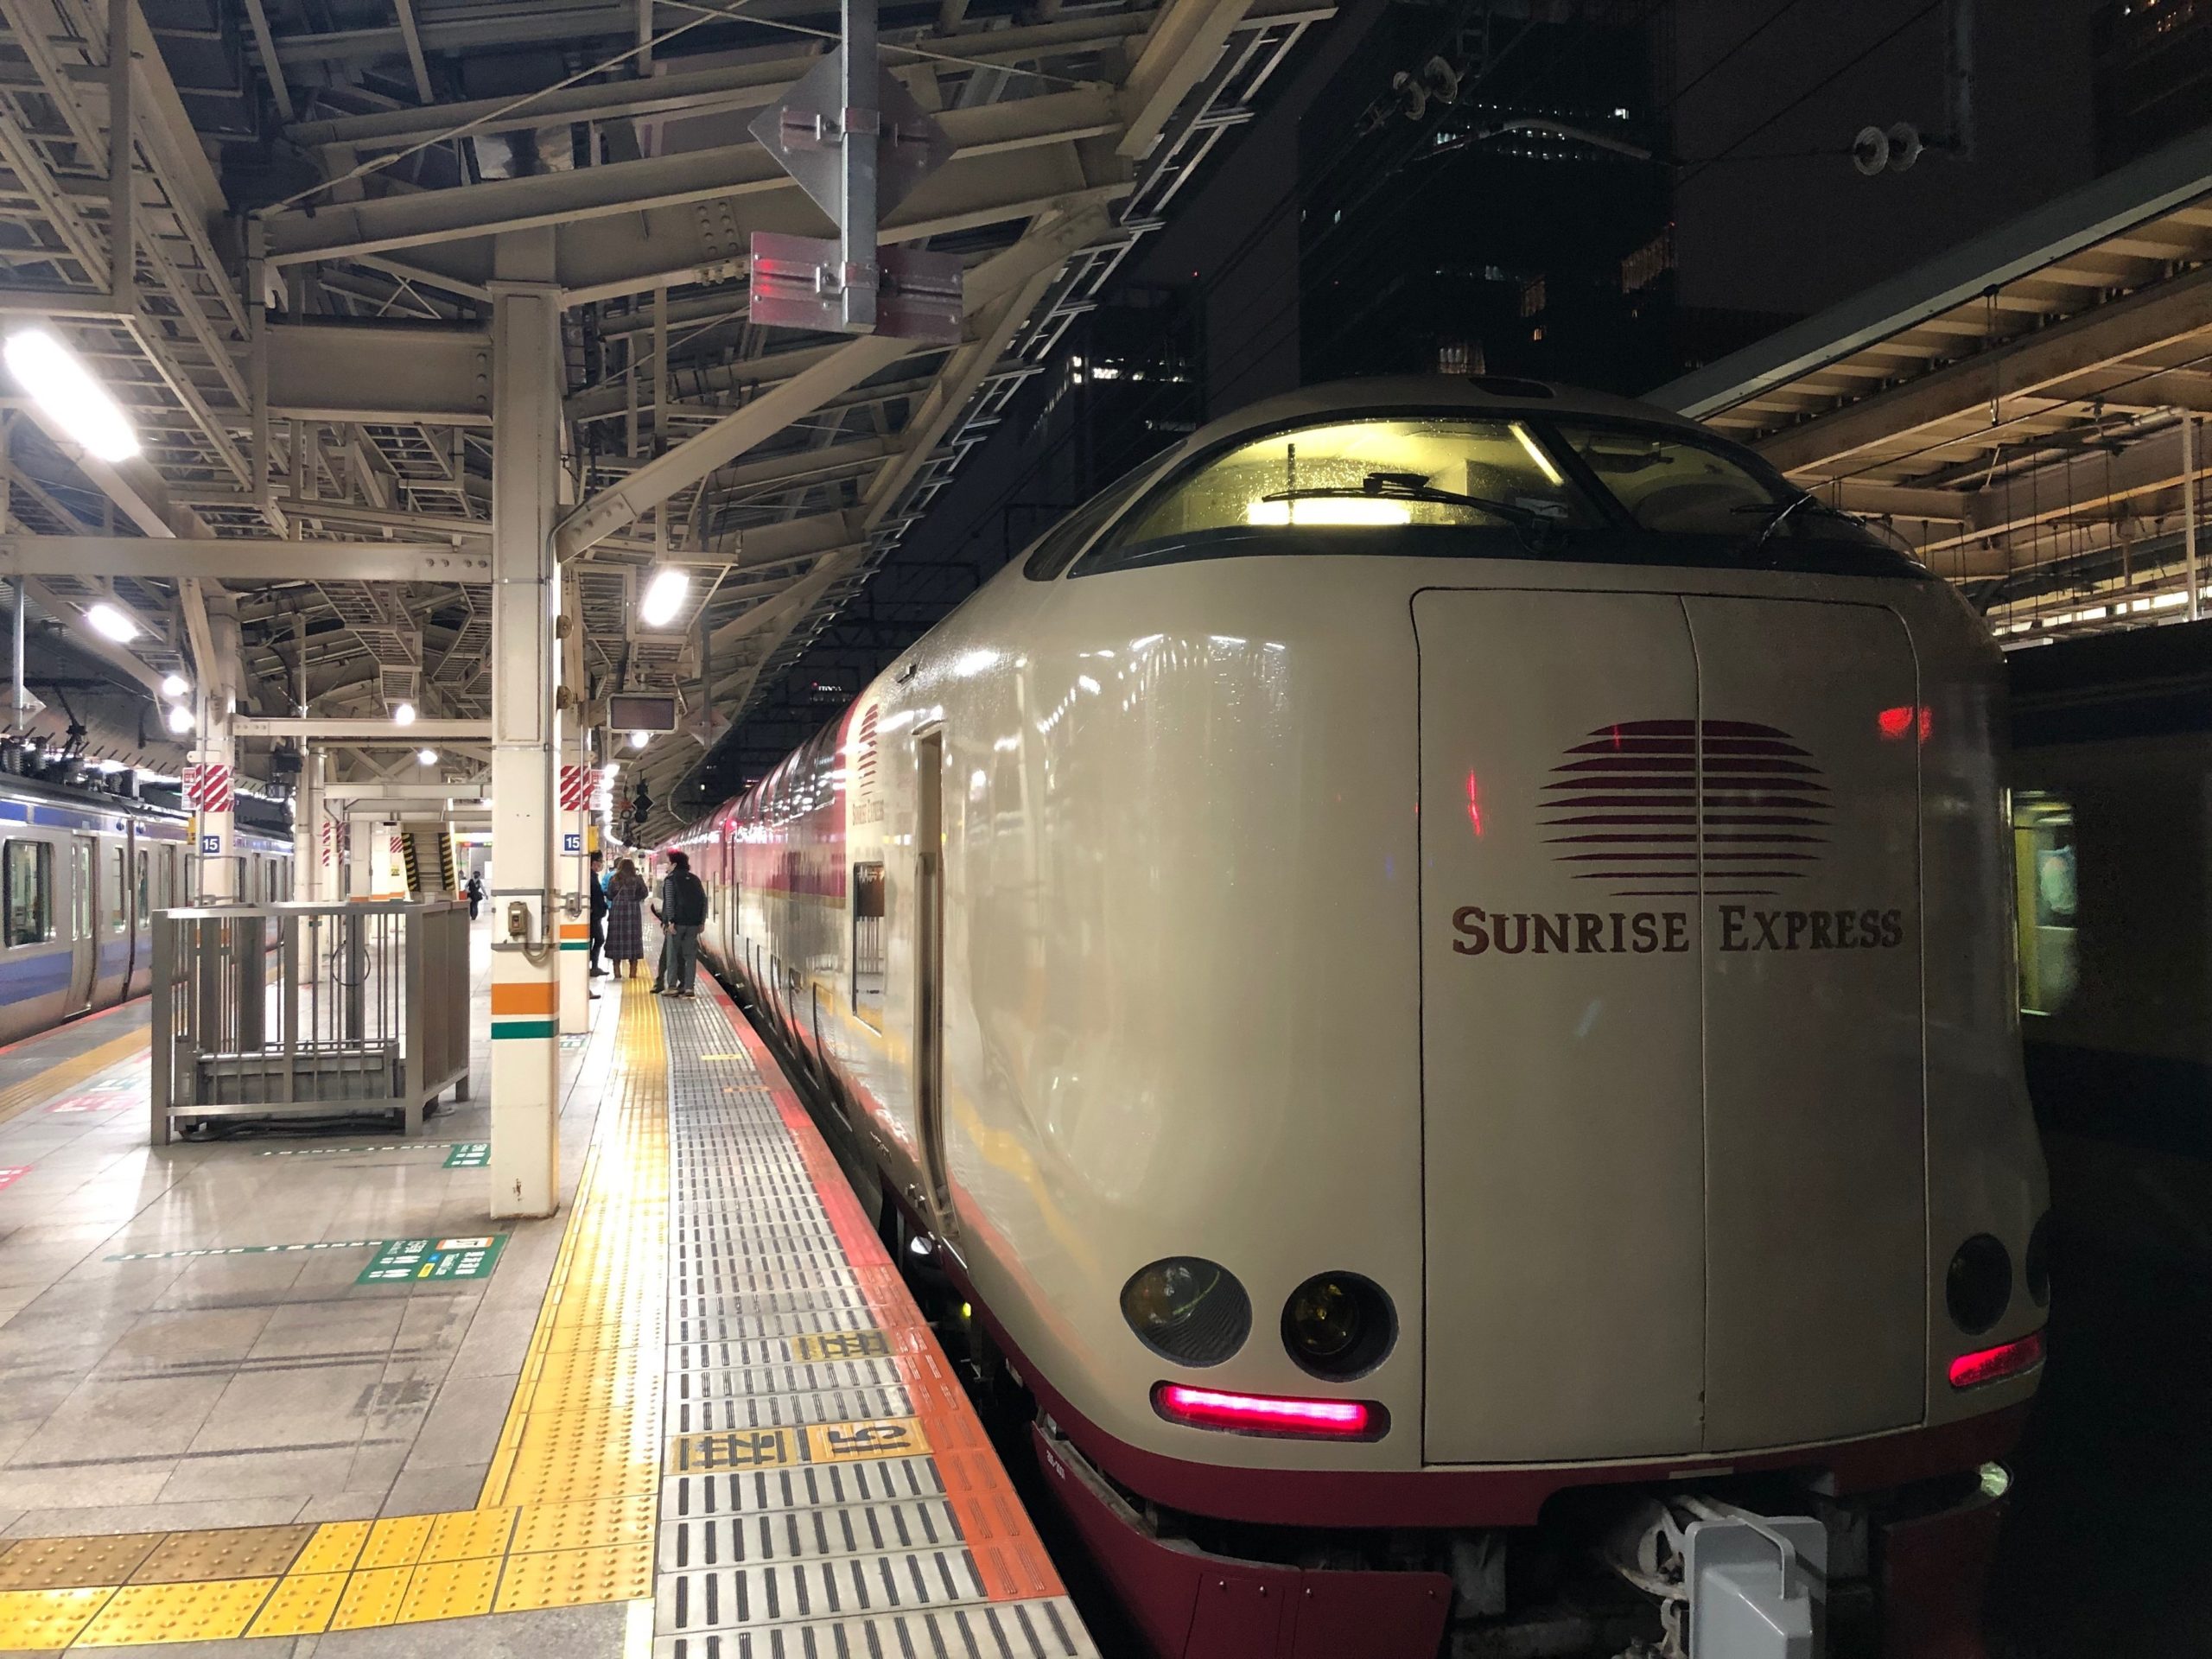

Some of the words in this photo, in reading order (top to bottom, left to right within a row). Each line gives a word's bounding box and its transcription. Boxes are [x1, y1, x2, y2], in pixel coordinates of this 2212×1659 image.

[203, 838, 218, 850] 15
[566, 836, 580, 849] 15
[1452, 906, 1689, 956] SUNRISE
[1719, 905, 1904, 952] EXPRESS
[829, 1425, 912, 1453] 15
